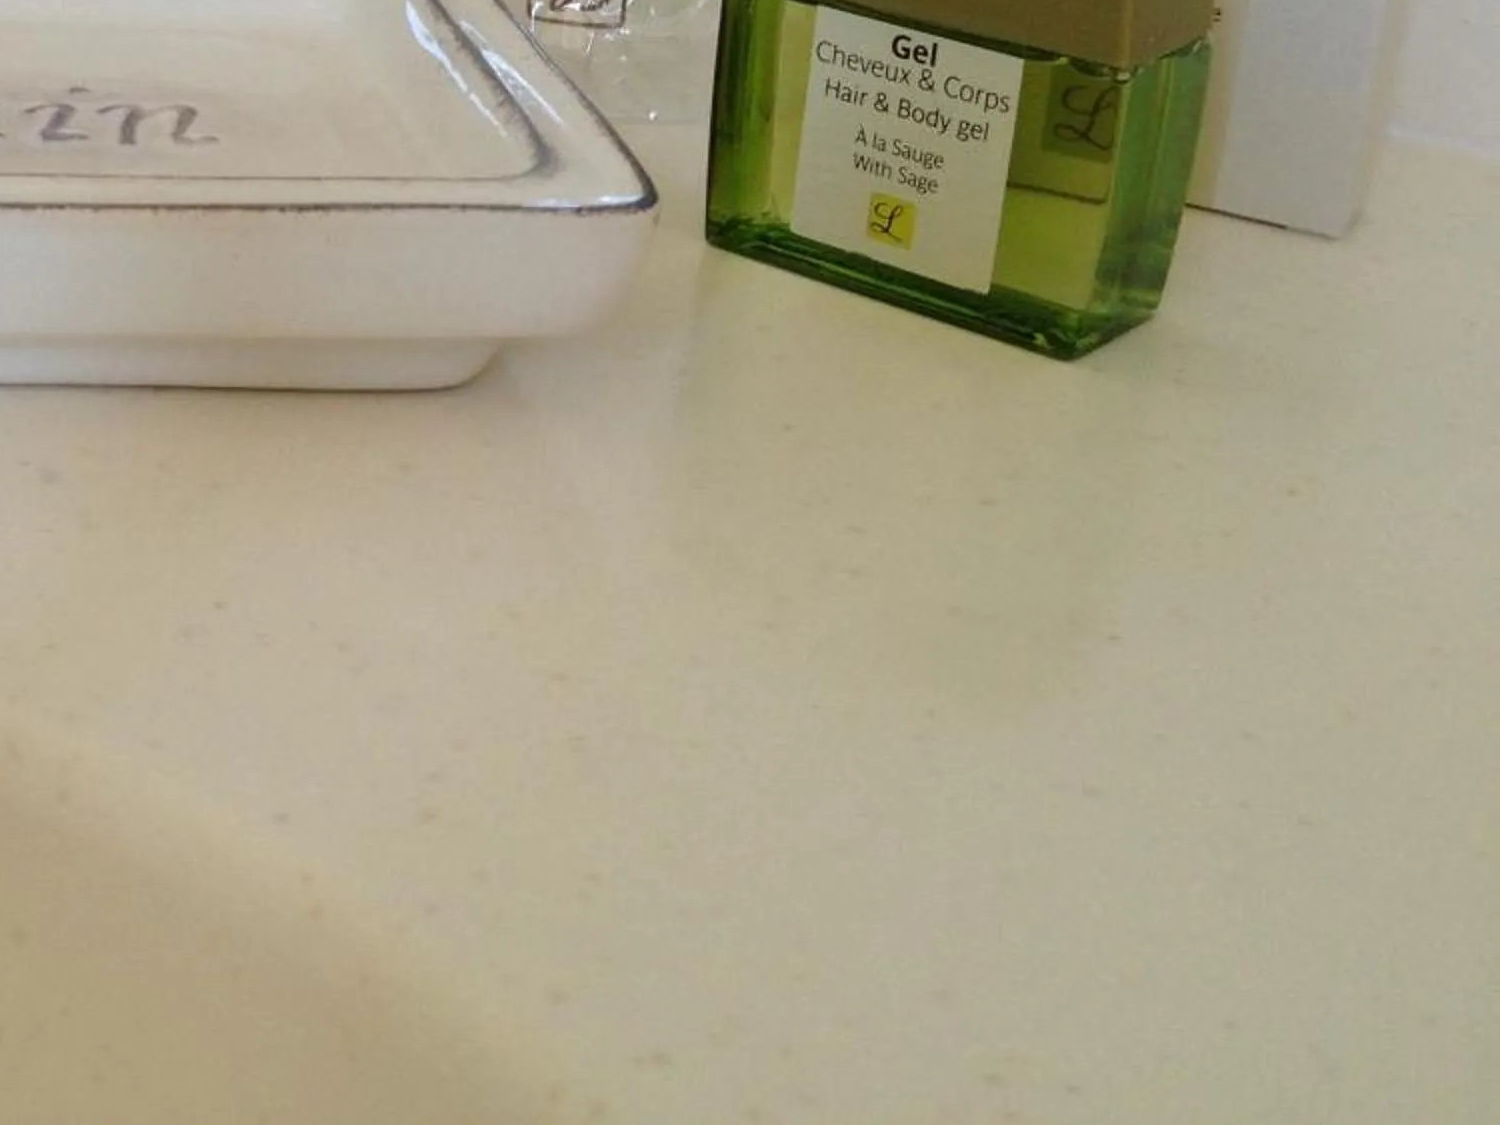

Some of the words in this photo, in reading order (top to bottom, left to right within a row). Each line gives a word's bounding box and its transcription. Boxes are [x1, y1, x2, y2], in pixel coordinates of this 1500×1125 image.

[891, 34, 939, 67] Gel
[816, 40, 911, 85] Cheveux
[917, 68, 935, 92] &
[943, 75, 1011, 113] Corps
[825, 77, 869, 106] Hair
[873, 91, 889, 113] &
[897, 98, 950, 135] Body
[956, 119, 990, 142] gel
[871, 131, 887, 152] la
[891, 138, 945, 170] Sauge
[853, 152, 893, 180] With
[898, 165, 940, 195] Sage
